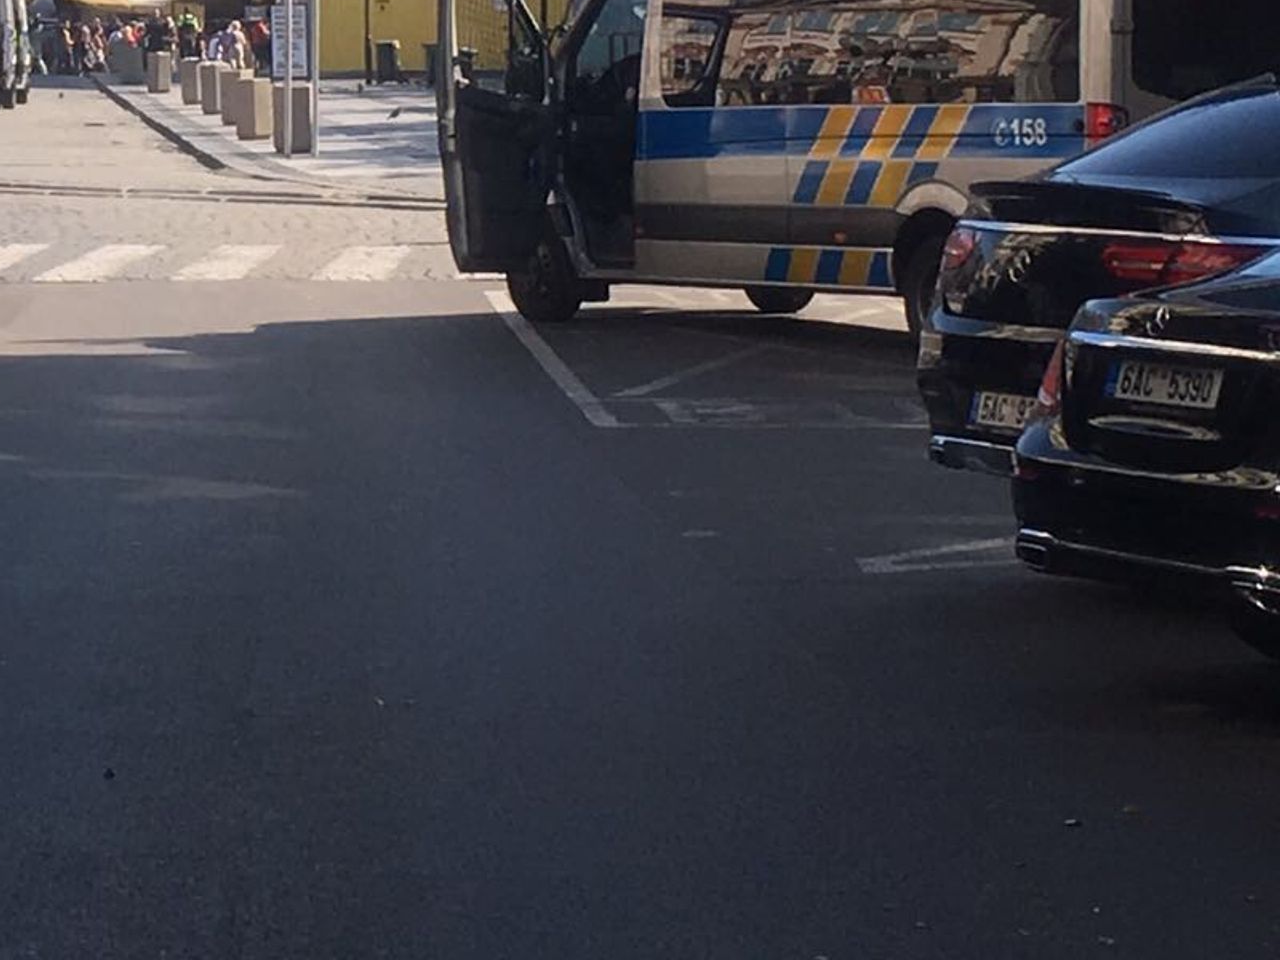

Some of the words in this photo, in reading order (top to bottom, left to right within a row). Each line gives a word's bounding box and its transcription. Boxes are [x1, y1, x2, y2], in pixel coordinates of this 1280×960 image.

[1010, 117, 1048, 147] 158
[1121, 364, 1153, 396] 6AC
[1166, 369, 1216, 403] 5390
